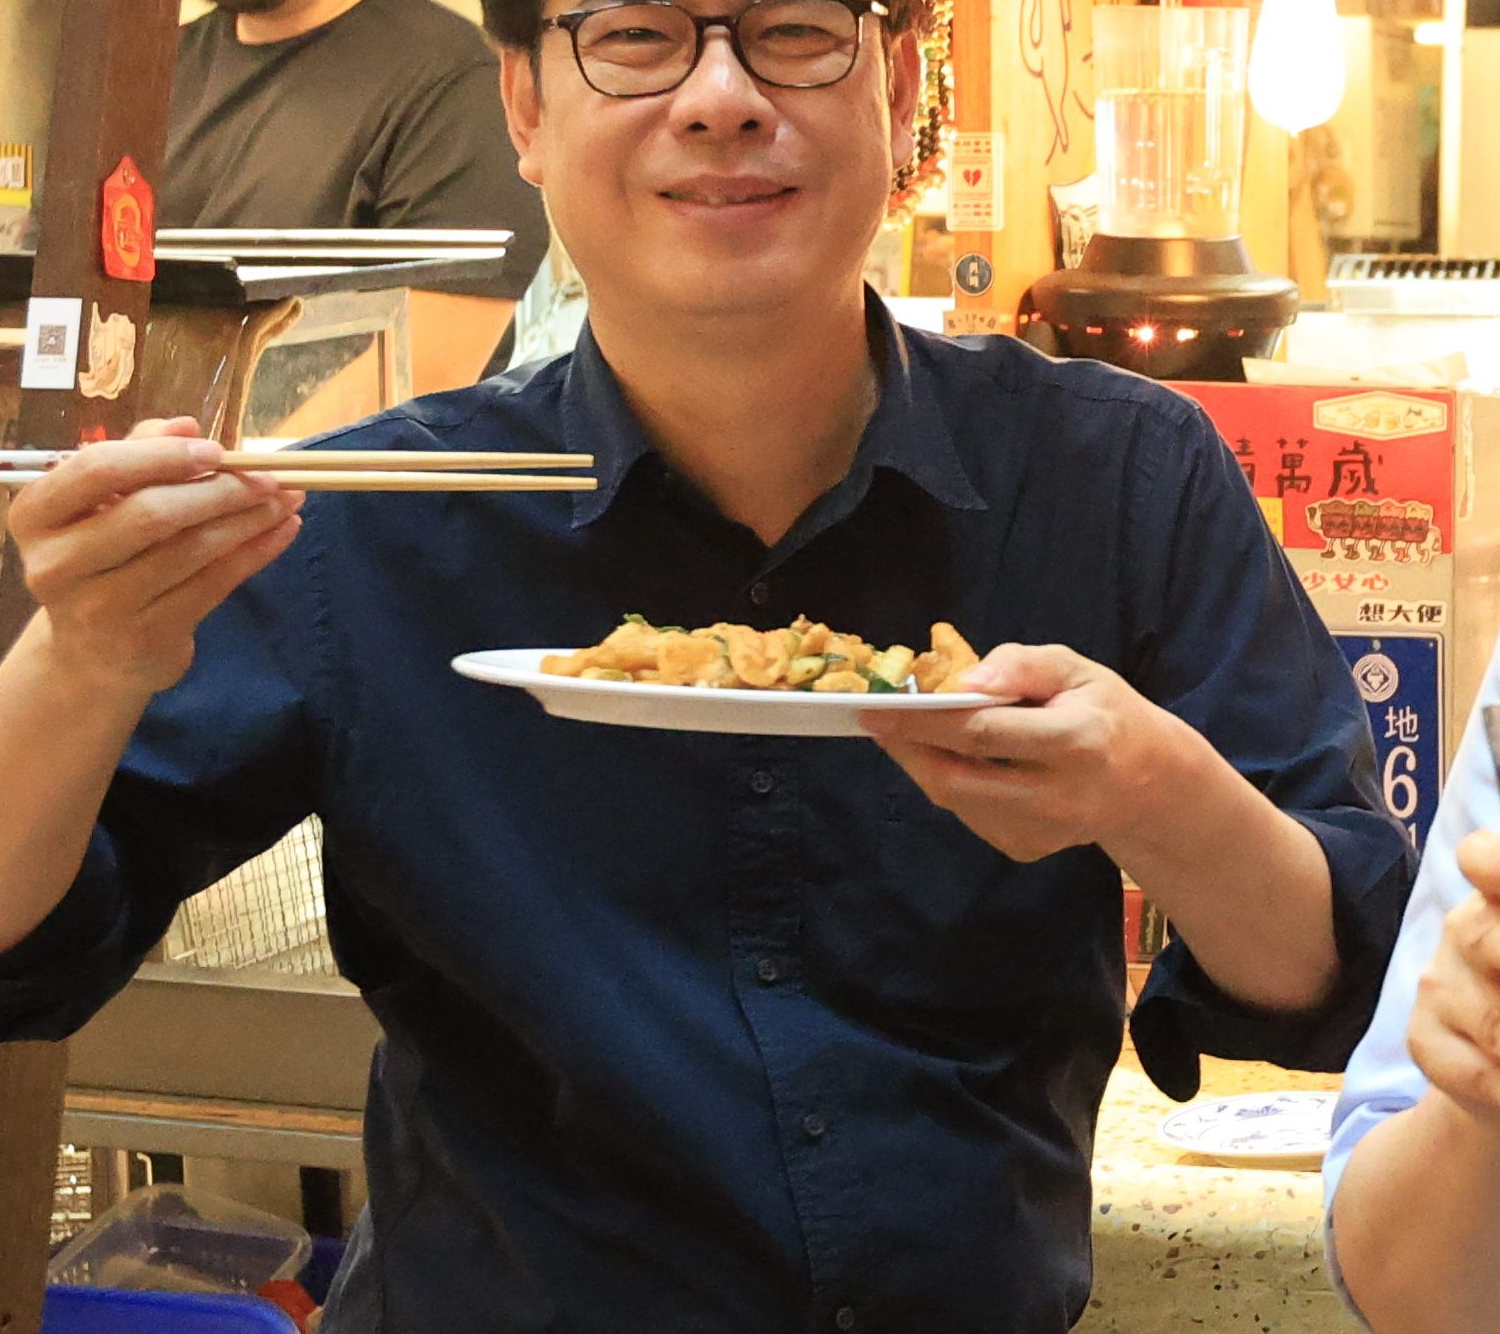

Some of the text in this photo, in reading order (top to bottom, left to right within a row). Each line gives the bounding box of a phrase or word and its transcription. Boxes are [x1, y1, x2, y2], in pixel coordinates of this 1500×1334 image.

[1301, 571, 1390, 593] 少女心
[1358, 603, 1445, 624] 想大便
[1383, 705, 1420, 742] 地
[1383, 746, 1418, 819] 6
